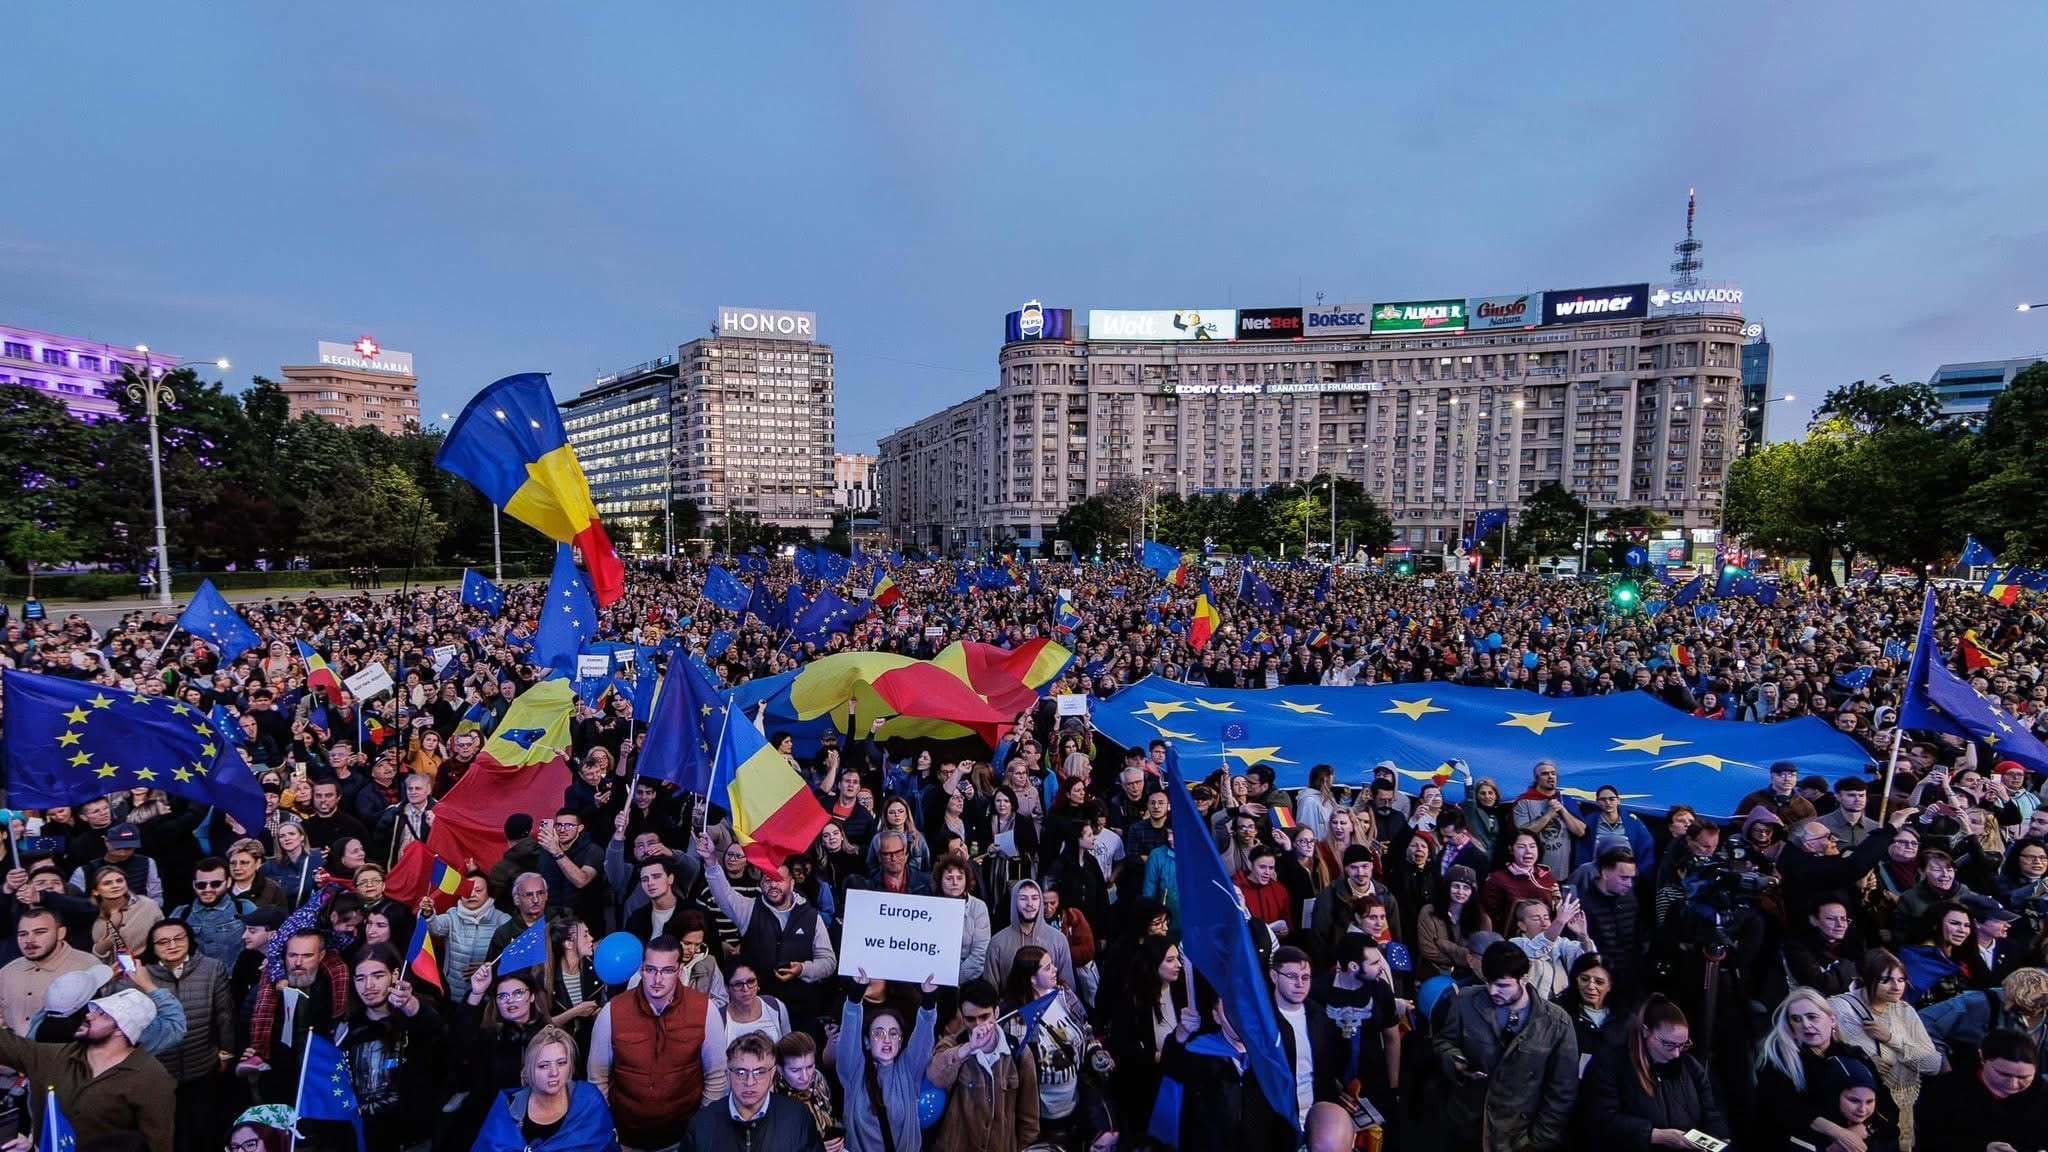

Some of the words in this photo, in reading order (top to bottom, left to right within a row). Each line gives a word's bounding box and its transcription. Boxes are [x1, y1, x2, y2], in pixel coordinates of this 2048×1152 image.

[1671, 287, 1743, 304] SANADOR
[1477, 302, 1527, 318] Giusto
[1555, 296, 1632, 316] winner
[725, 313, 811, 334] HONOR
[1021, 318, 1042, 326] PEPSI
[1103, 315, 1154, 337] Wolt
[1242, 316, 1299, 330] NetBet
[1308, 312, 1366, 328] BORSEC
[322, 354, 368, 368] REGINA
[371, 361, 409, 373] MARIA
[1271, 383, 1319, 393] SANATATEA
[1327, 382, 1378, 391] FRUMUSETE
[879, 903, 933, 921] Europe,
[864, 936, 886, 949] we
[889, 936, 940, 956] belong.
